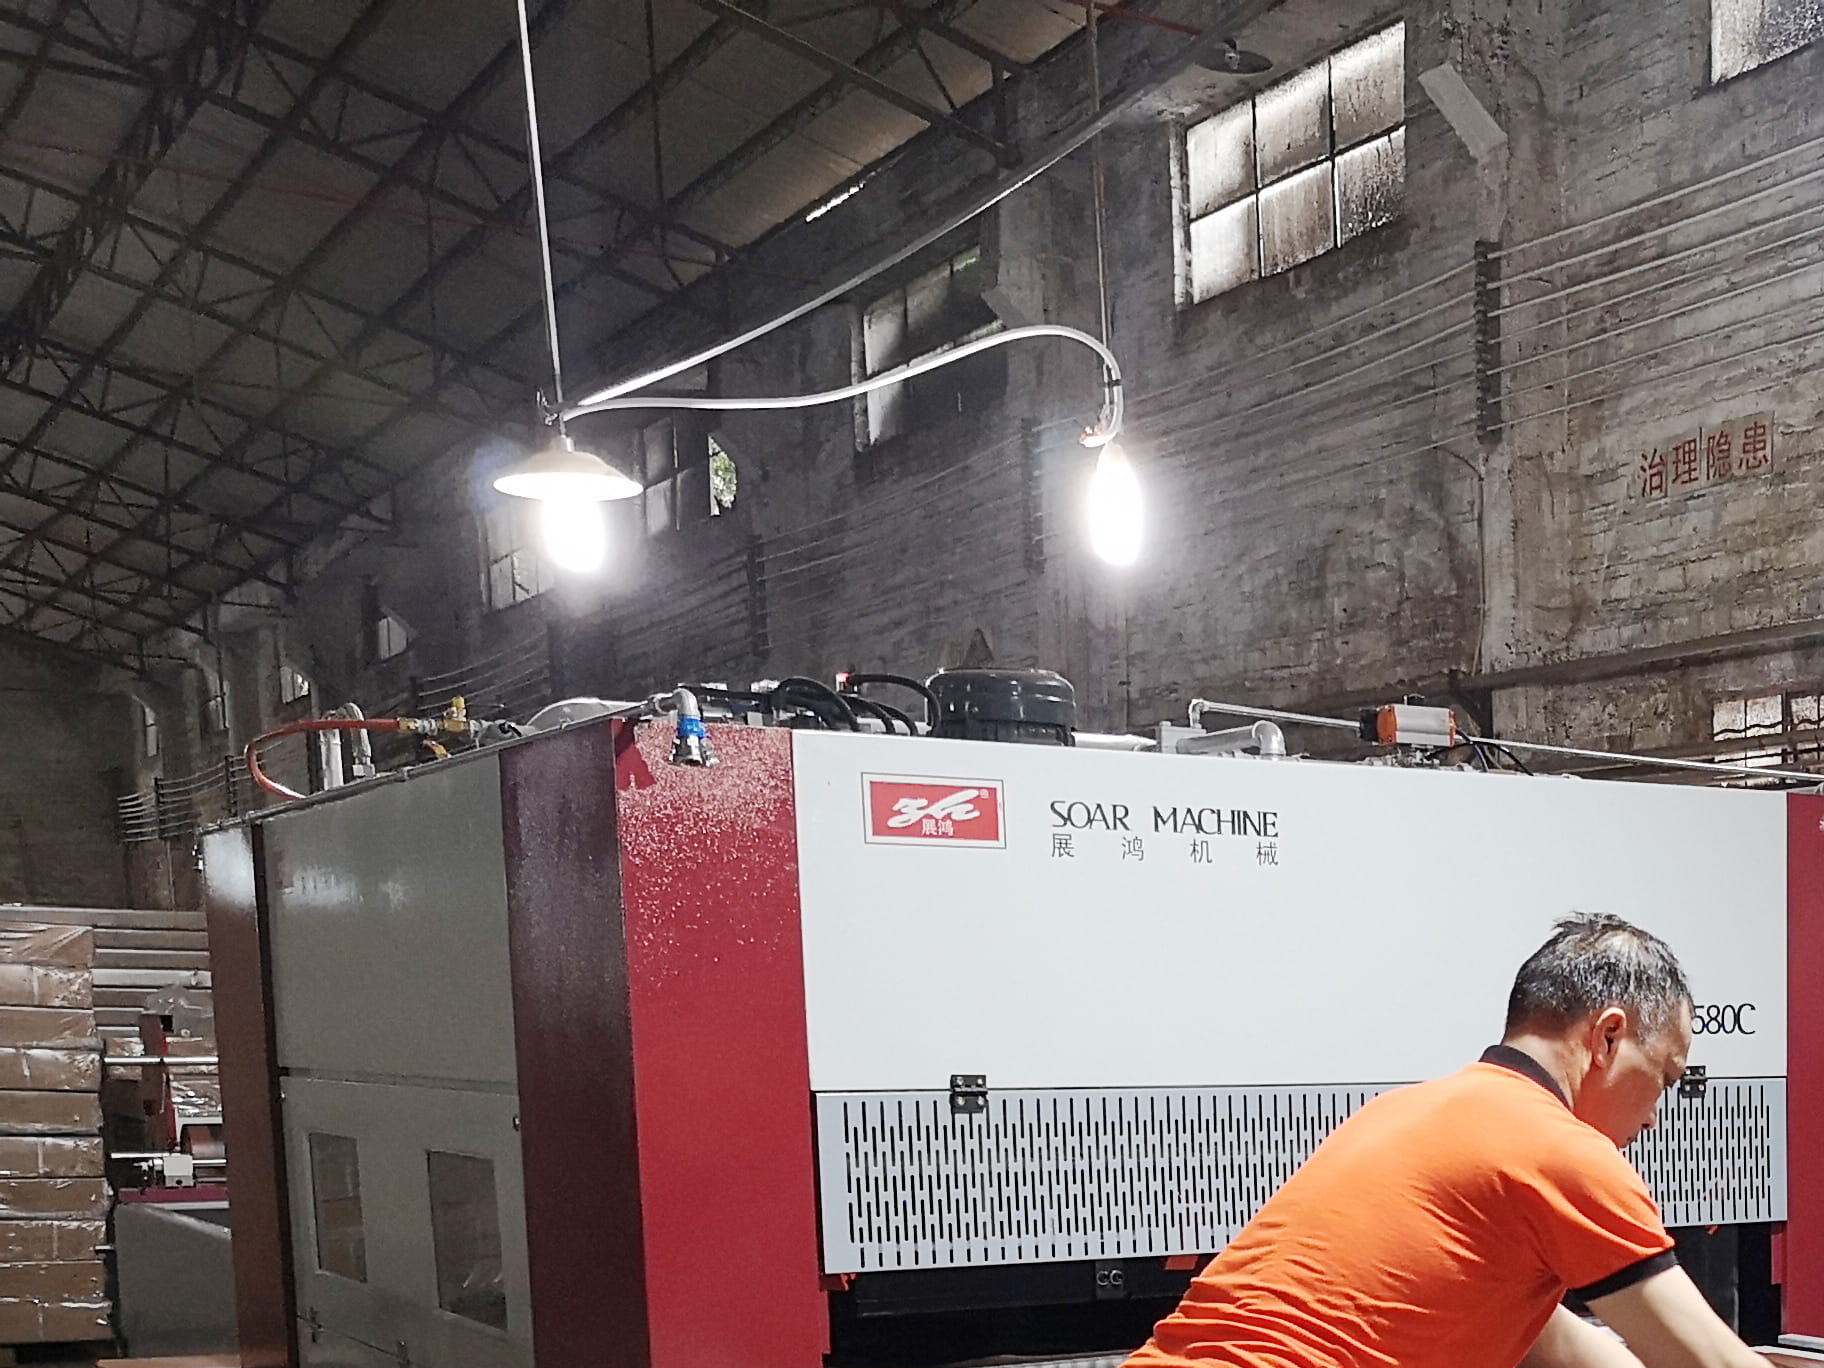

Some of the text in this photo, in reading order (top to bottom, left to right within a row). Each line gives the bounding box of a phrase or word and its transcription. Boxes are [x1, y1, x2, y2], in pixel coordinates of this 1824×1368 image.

[1640, 421, 1769, 498] 治理隐患
[921, 819, 954, 837] 展鸿
[1050, 800, 1279, 838] SOAR MACHINE
[1691, 1003, 1756, 1035] 580C
